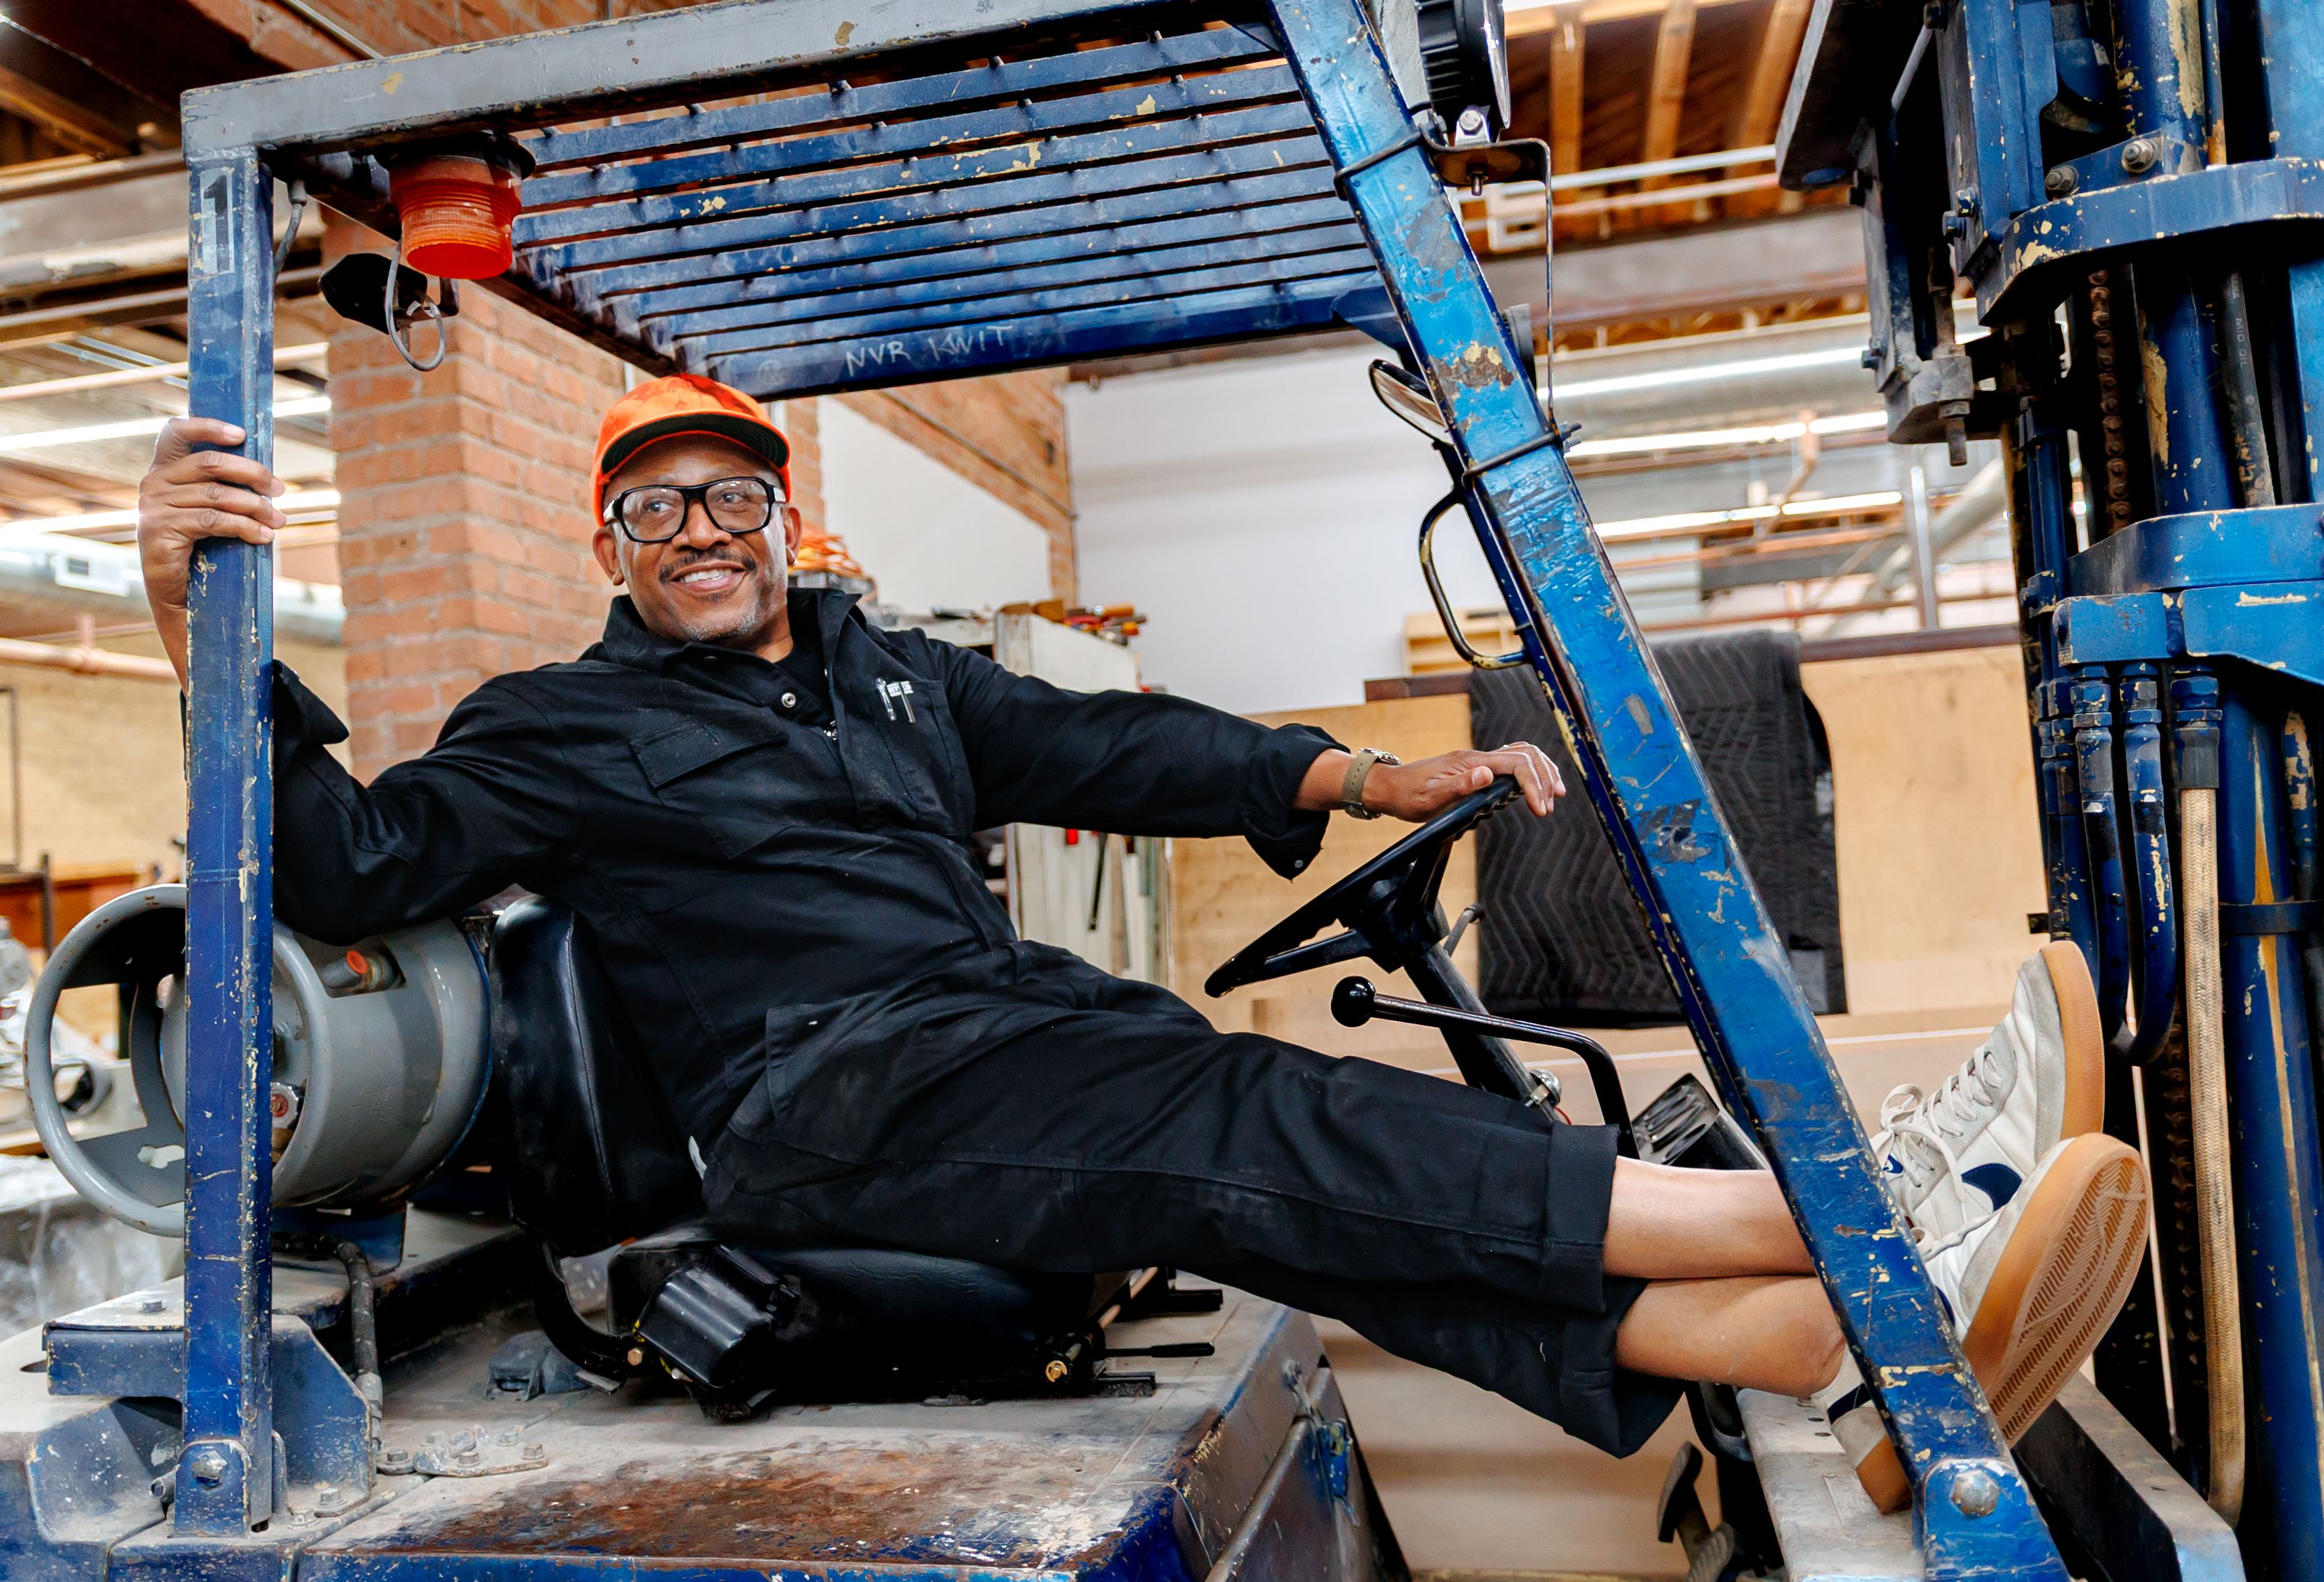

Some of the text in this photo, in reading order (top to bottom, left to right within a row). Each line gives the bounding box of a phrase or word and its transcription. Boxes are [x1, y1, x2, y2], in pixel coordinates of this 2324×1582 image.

[203, 174, 230, 272] 1
[845, 324, 1013, 377] NVR KWIT
[2235, 318, 2248, 370] MID OIL
